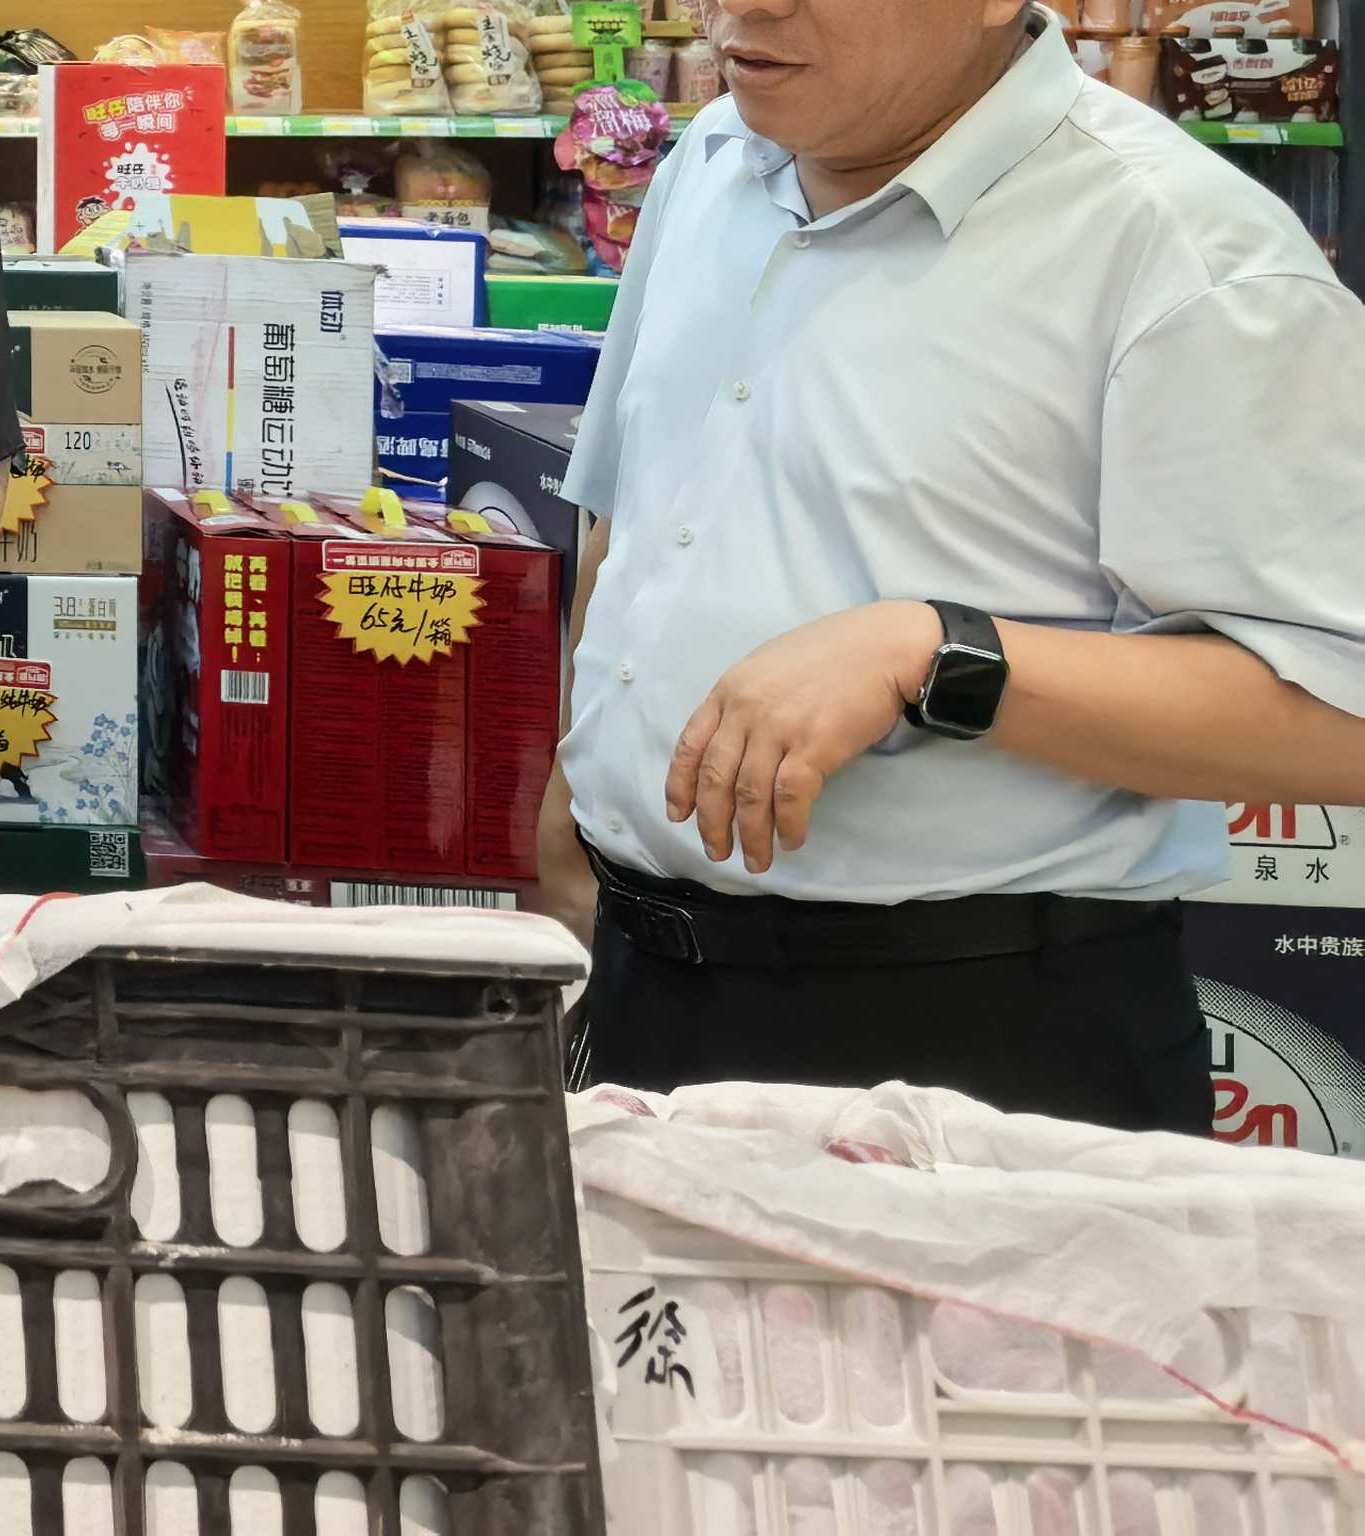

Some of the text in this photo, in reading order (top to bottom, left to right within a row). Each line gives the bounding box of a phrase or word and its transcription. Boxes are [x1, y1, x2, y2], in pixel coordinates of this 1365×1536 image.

[83, 91, 183, 123] 旺仔陪伴你
[100, 114, 174, 139] 每一瞬间
[116, 163, 145, 175] 旺仔
[65, 431, 91, 450] 120
[349, 573, 457, 605] 旺仔牛奶
[1274, 934, 1365, 958] 水中贵族
